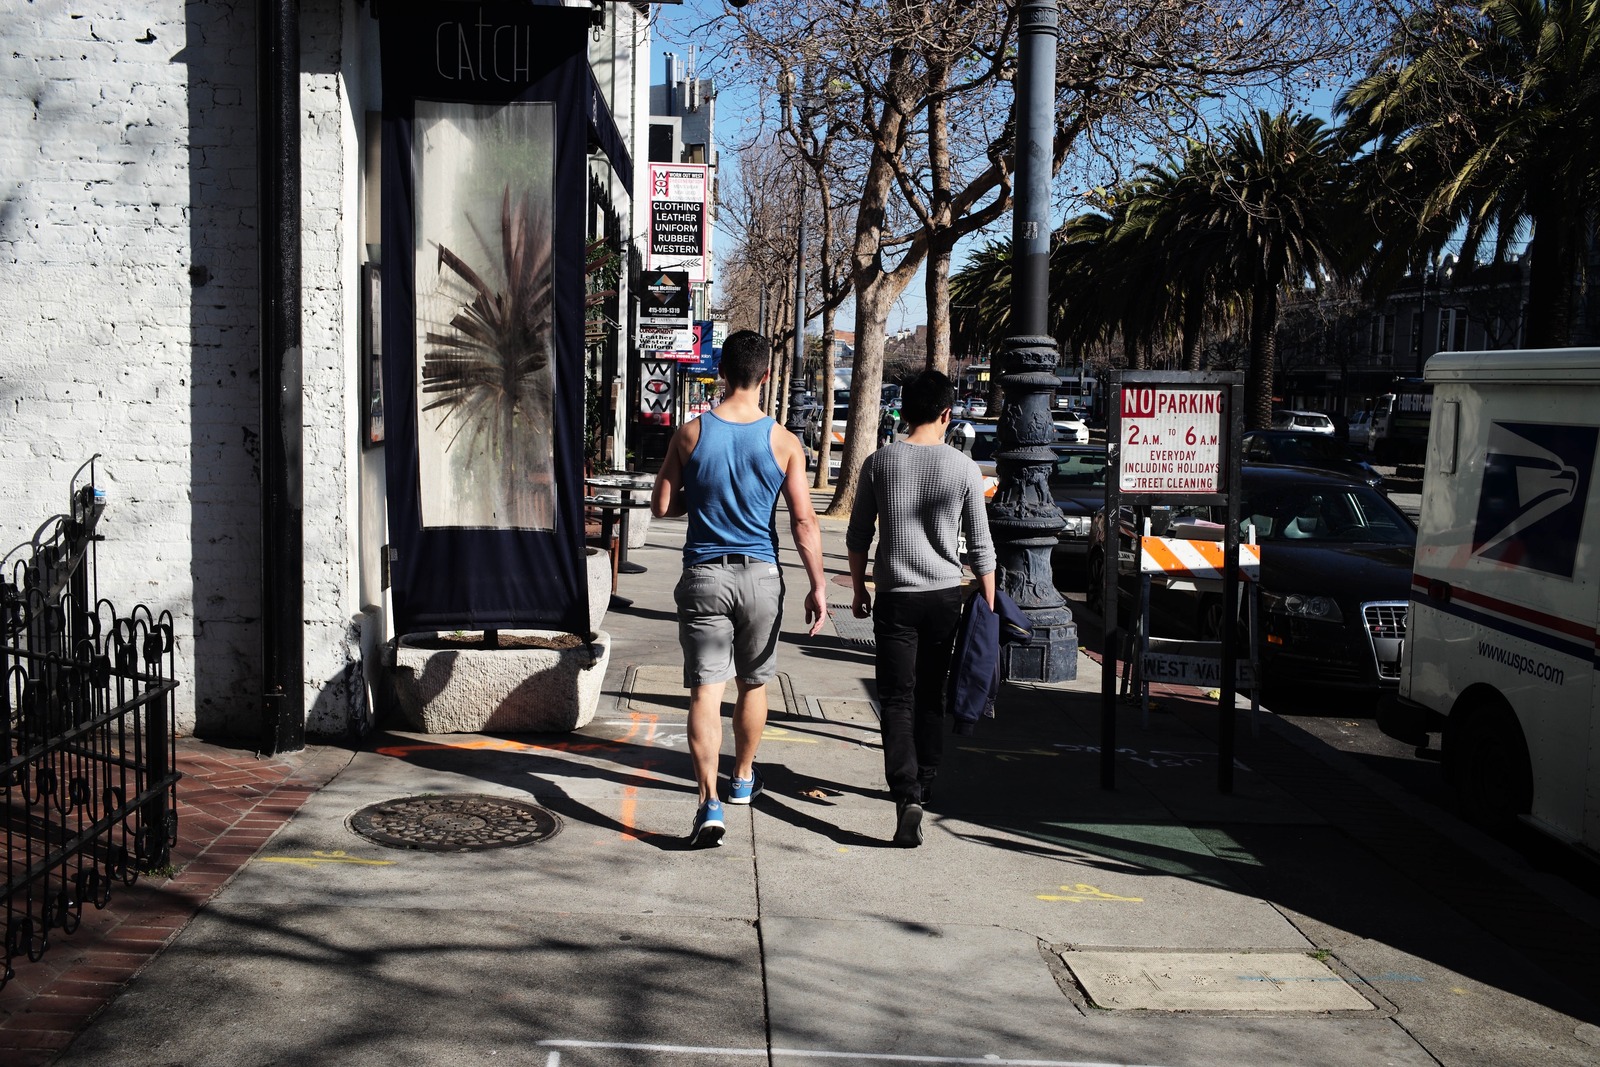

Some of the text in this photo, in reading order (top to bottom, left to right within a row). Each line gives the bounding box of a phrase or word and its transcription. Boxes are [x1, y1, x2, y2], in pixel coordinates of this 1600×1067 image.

[653, 202, 700, 211] CLOTHING
[656, 213, 697, 222] LEATHER
[655, 223, 698, 232] UNIFORM
[658, 234, 695, 243] RUBBER
[653, 244, 699, 254] WESTERN
[1124, 388, 1224, 414] NO PARKING
[1128, 425, 1140, 445] 2
[1142, 436, 1162, 445] A.M.
[1185, 425, 1197, 446] 6
[1150, 450, 1196, 461] EVERYDAY
[1125, 462, 1220, 473] INCLUDING HOLIDAYS
[1167, 477, 1213, 489] CLEANING
[1143, 658, 1189, 678] WEST
[1478, 640, 1564, 686] www.usps.com
